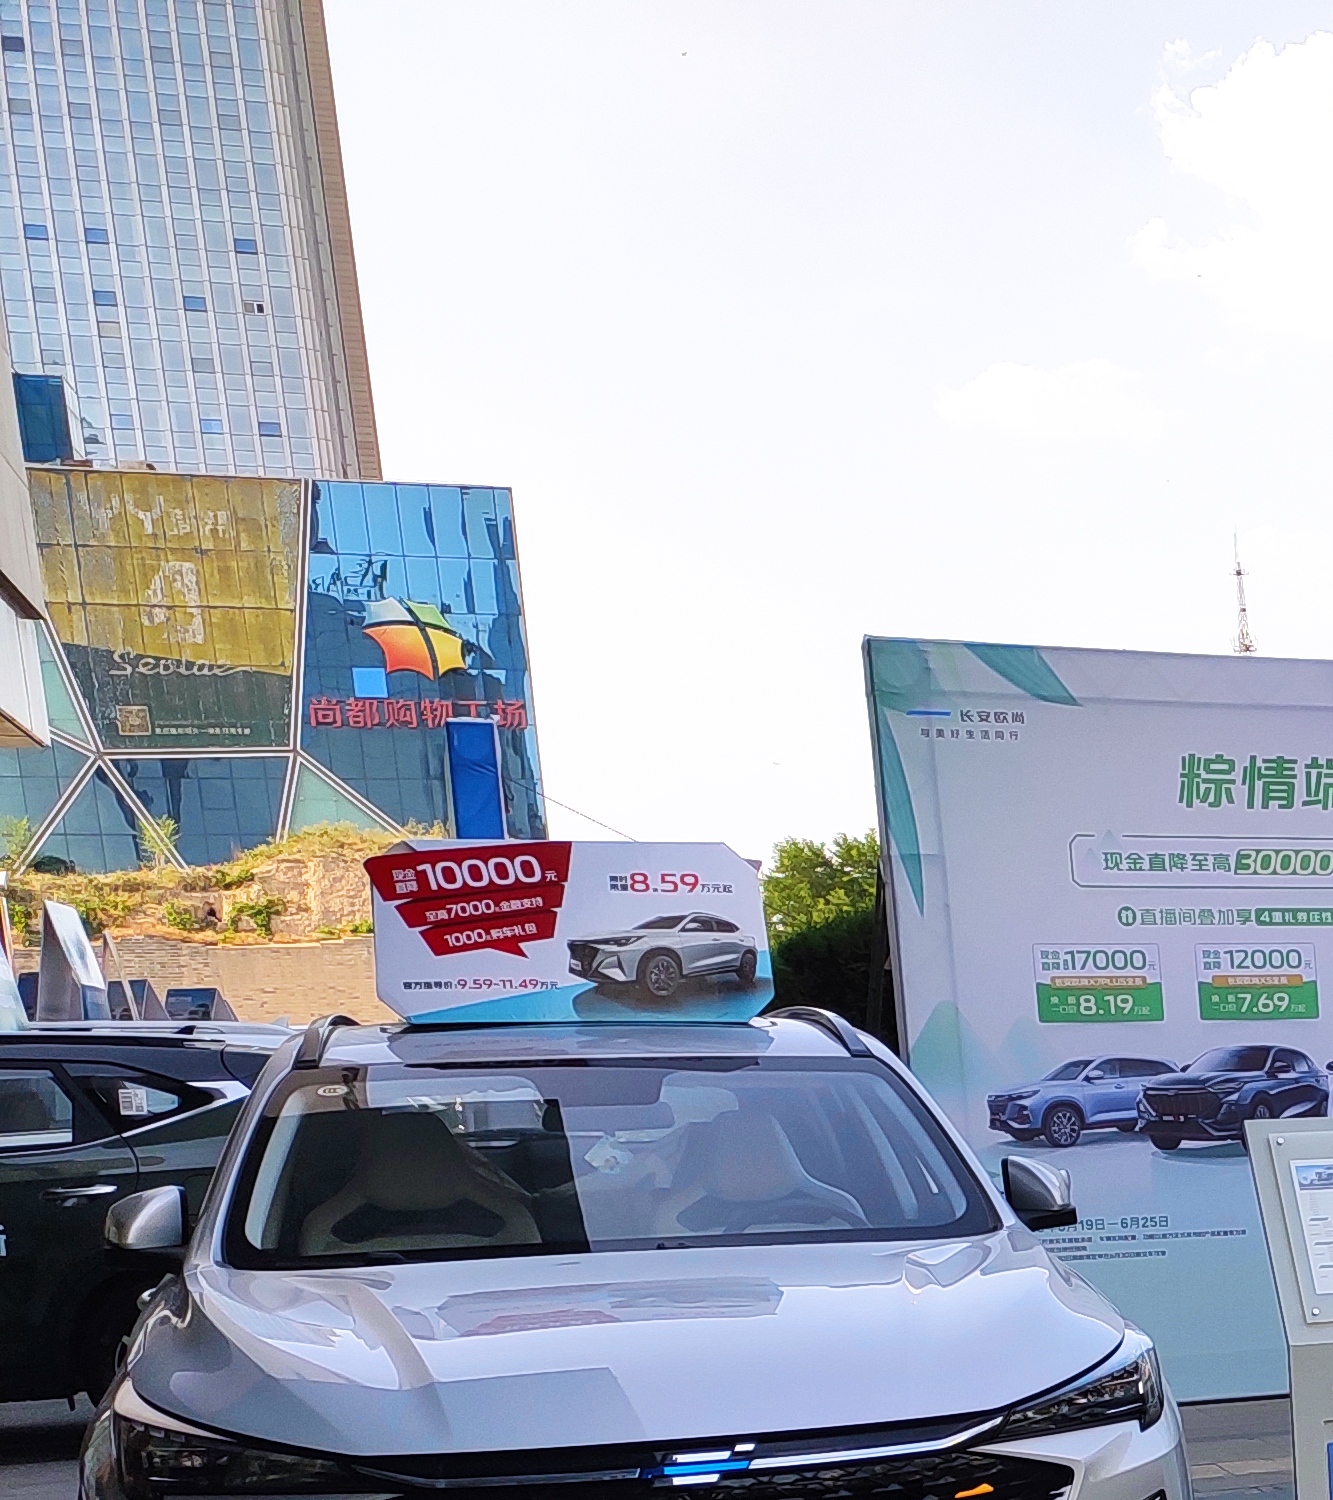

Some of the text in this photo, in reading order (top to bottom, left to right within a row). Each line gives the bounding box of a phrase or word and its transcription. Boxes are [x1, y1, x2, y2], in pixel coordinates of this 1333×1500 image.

[959, 709, 1026, 725] 长安欧尚
[1138, 908, 1254, 926] 直播间叠加享
